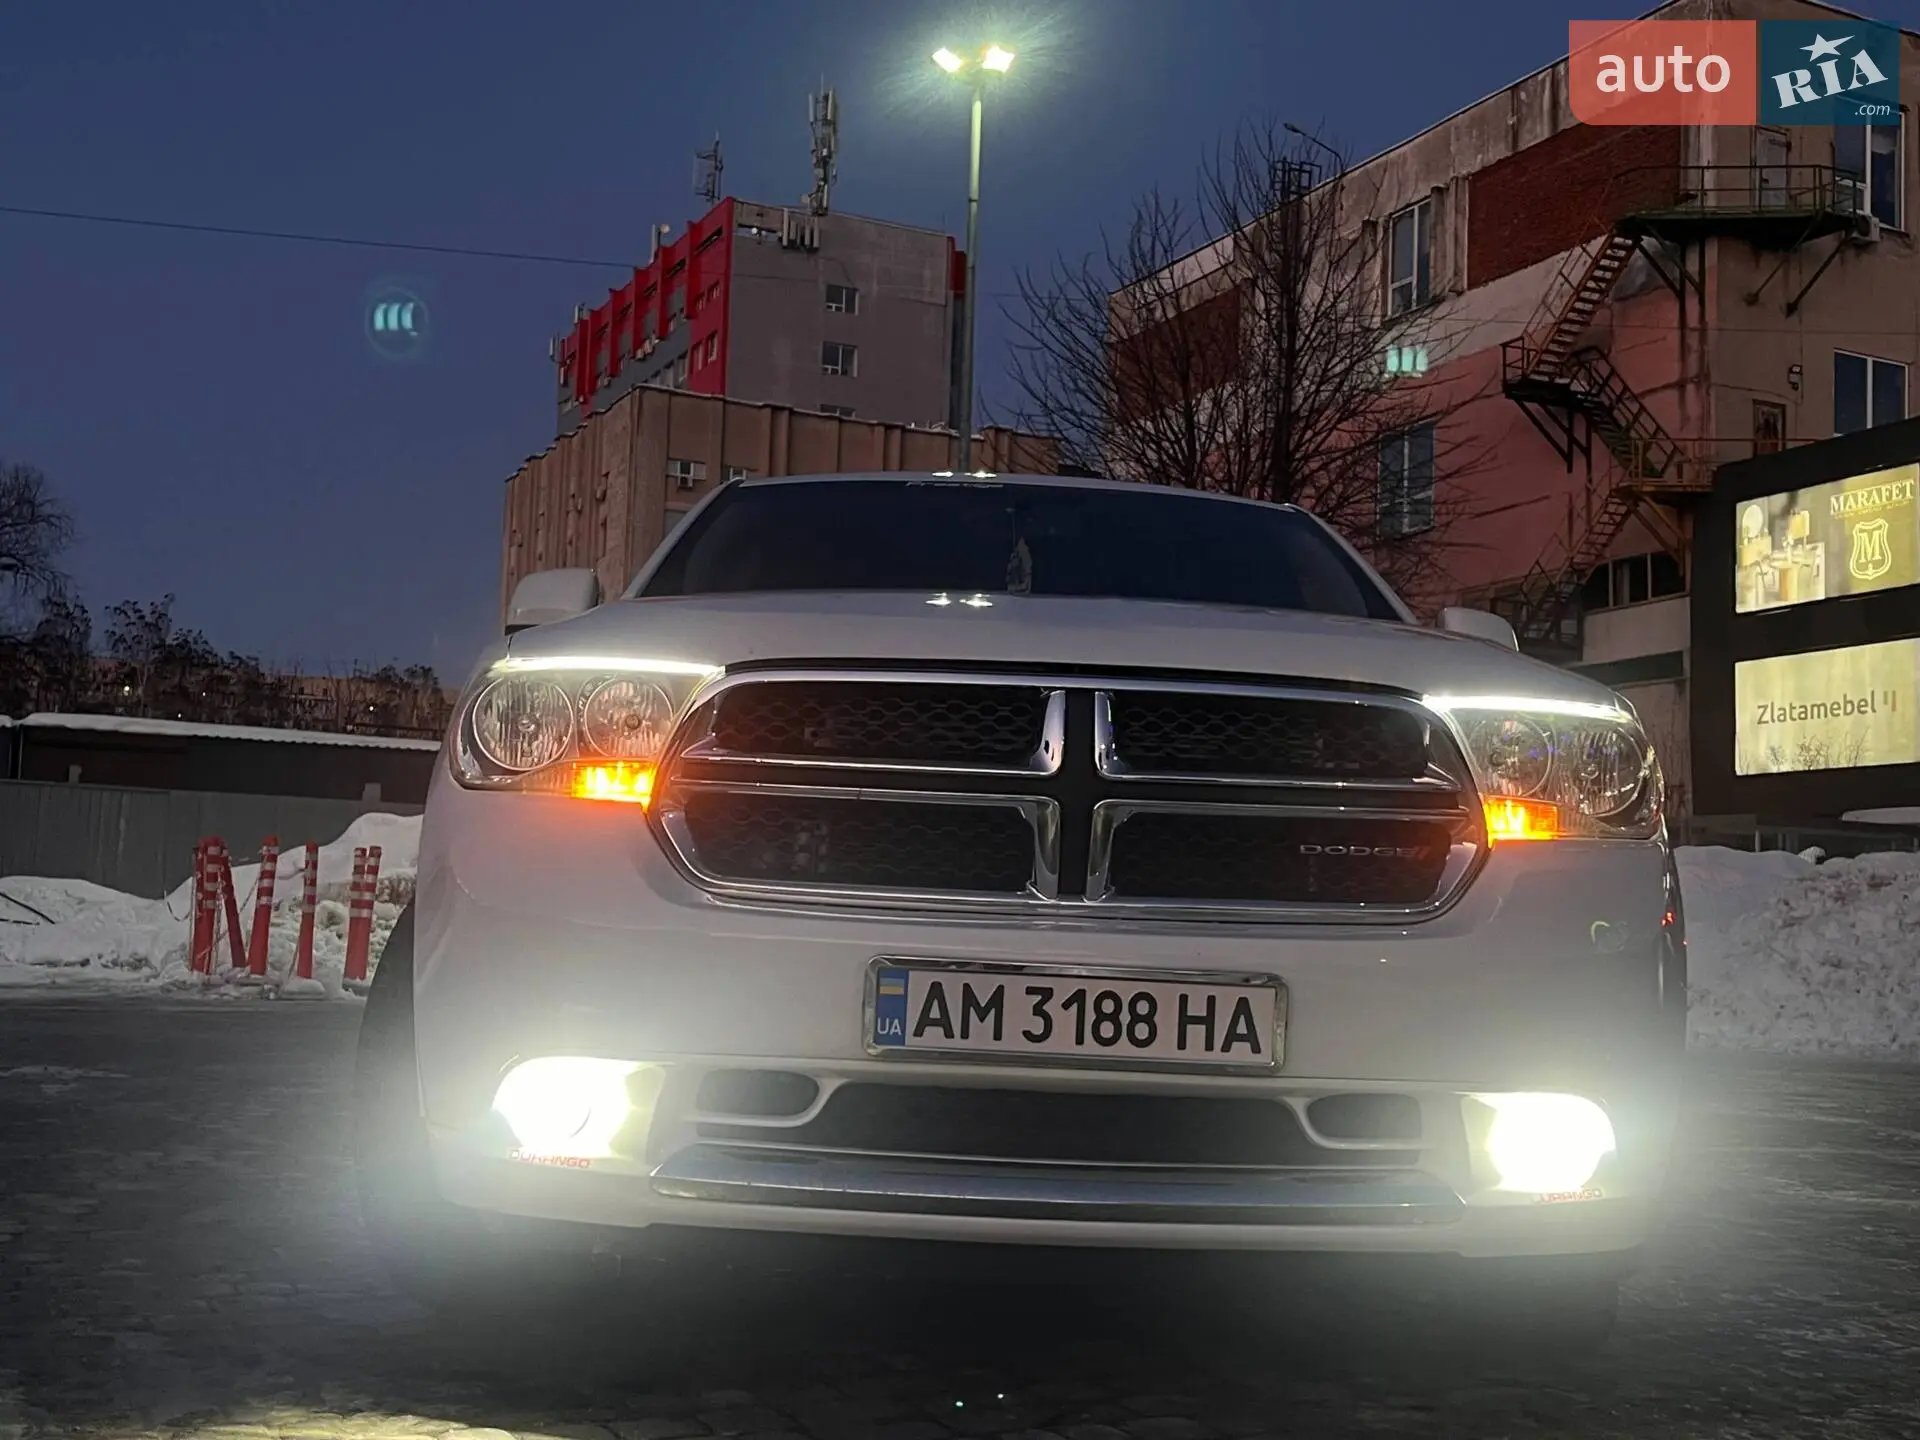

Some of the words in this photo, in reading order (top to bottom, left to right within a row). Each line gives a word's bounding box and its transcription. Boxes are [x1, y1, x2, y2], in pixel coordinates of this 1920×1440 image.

[1830, 478, 1915, 516] MARAFET
[1756, 690, 1877, 725] Zlatamebel
[1299, 845, 1416, 858] DODGE
[876, 1018, 902, 1036] UA
[912, 980, 1005, 1041] AM
[1022, 986, 1158, 1048] 3188
[1176, 993, 1261, 1054] HA
